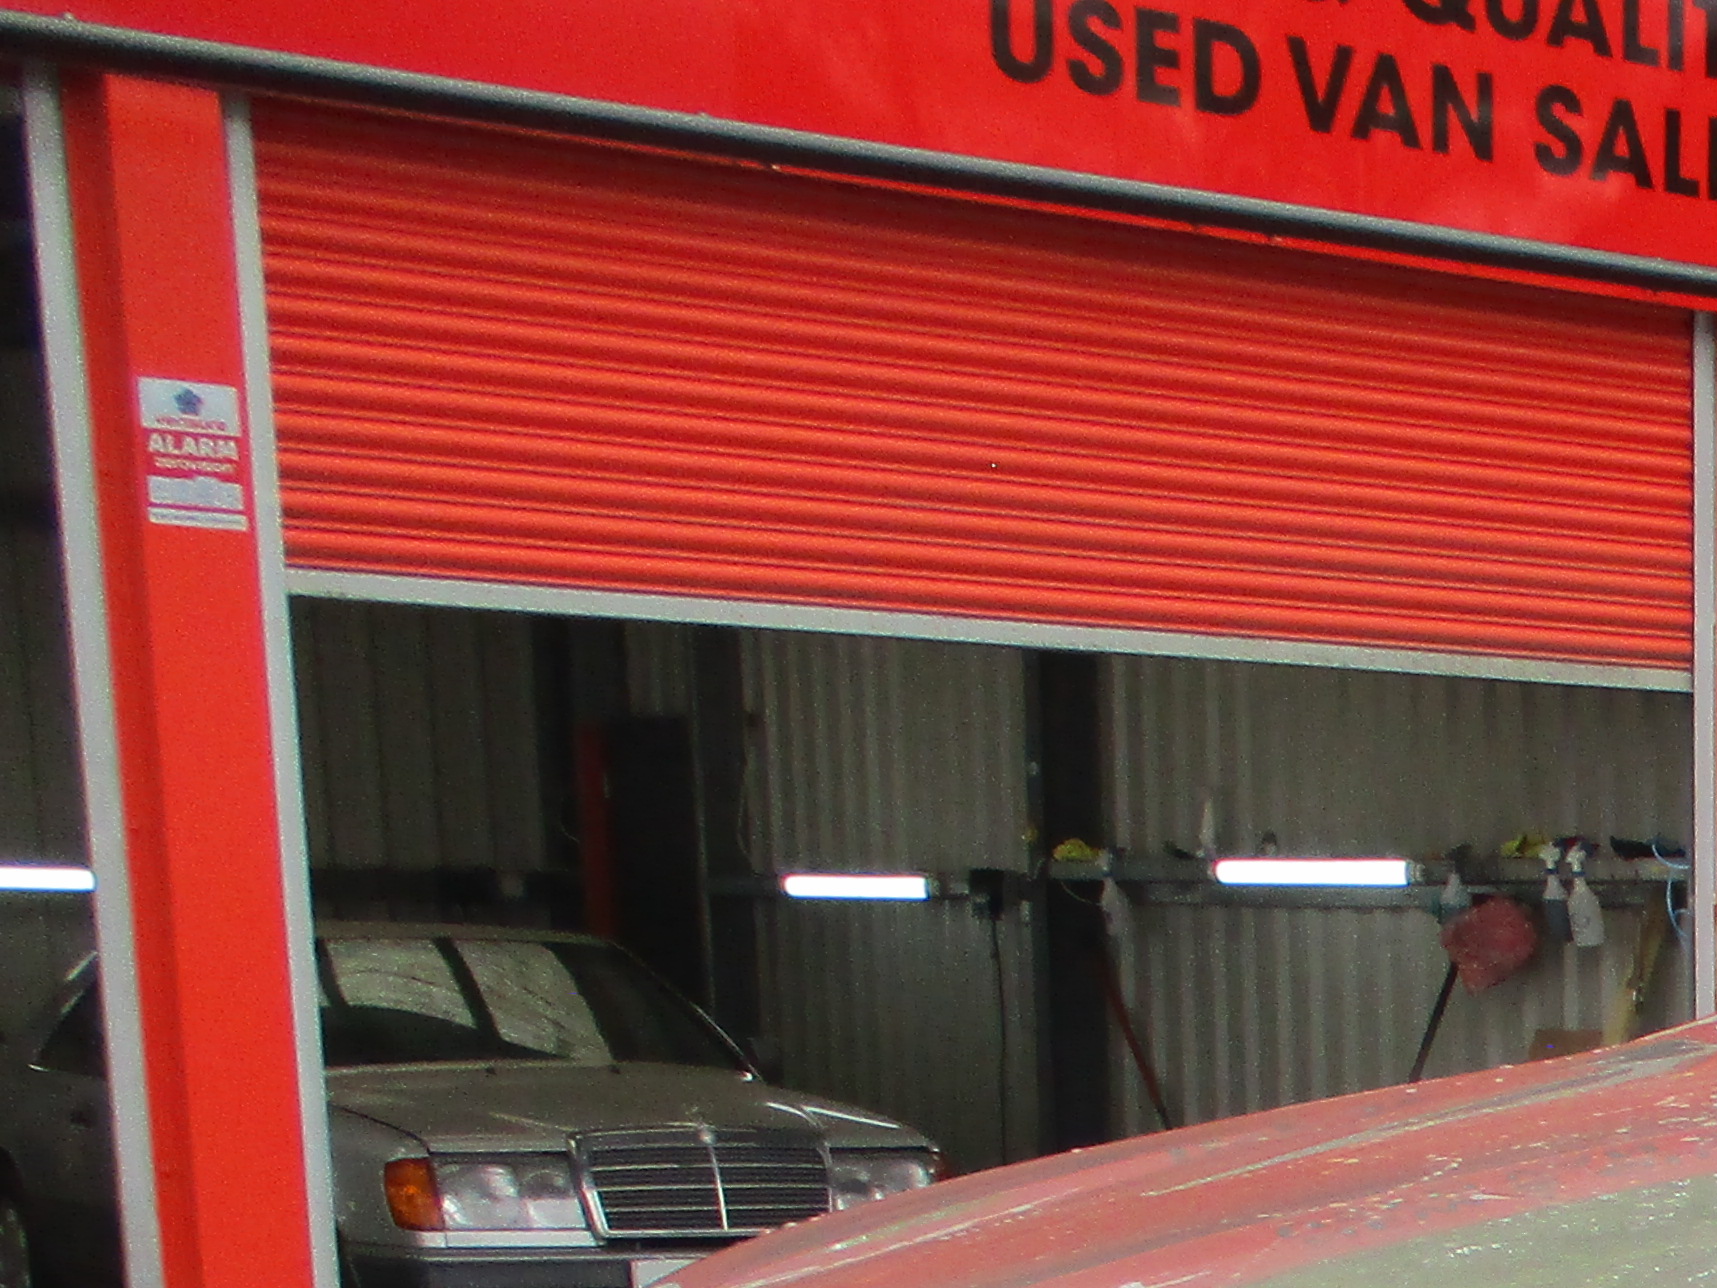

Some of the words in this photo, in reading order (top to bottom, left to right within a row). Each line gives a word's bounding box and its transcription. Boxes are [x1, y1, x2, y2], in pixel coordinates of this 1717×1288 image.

[990, 0, 1261, 117] USED
[1287, 34, 1494, 162] VAN
[150, 432, 240, 461] ALARM
